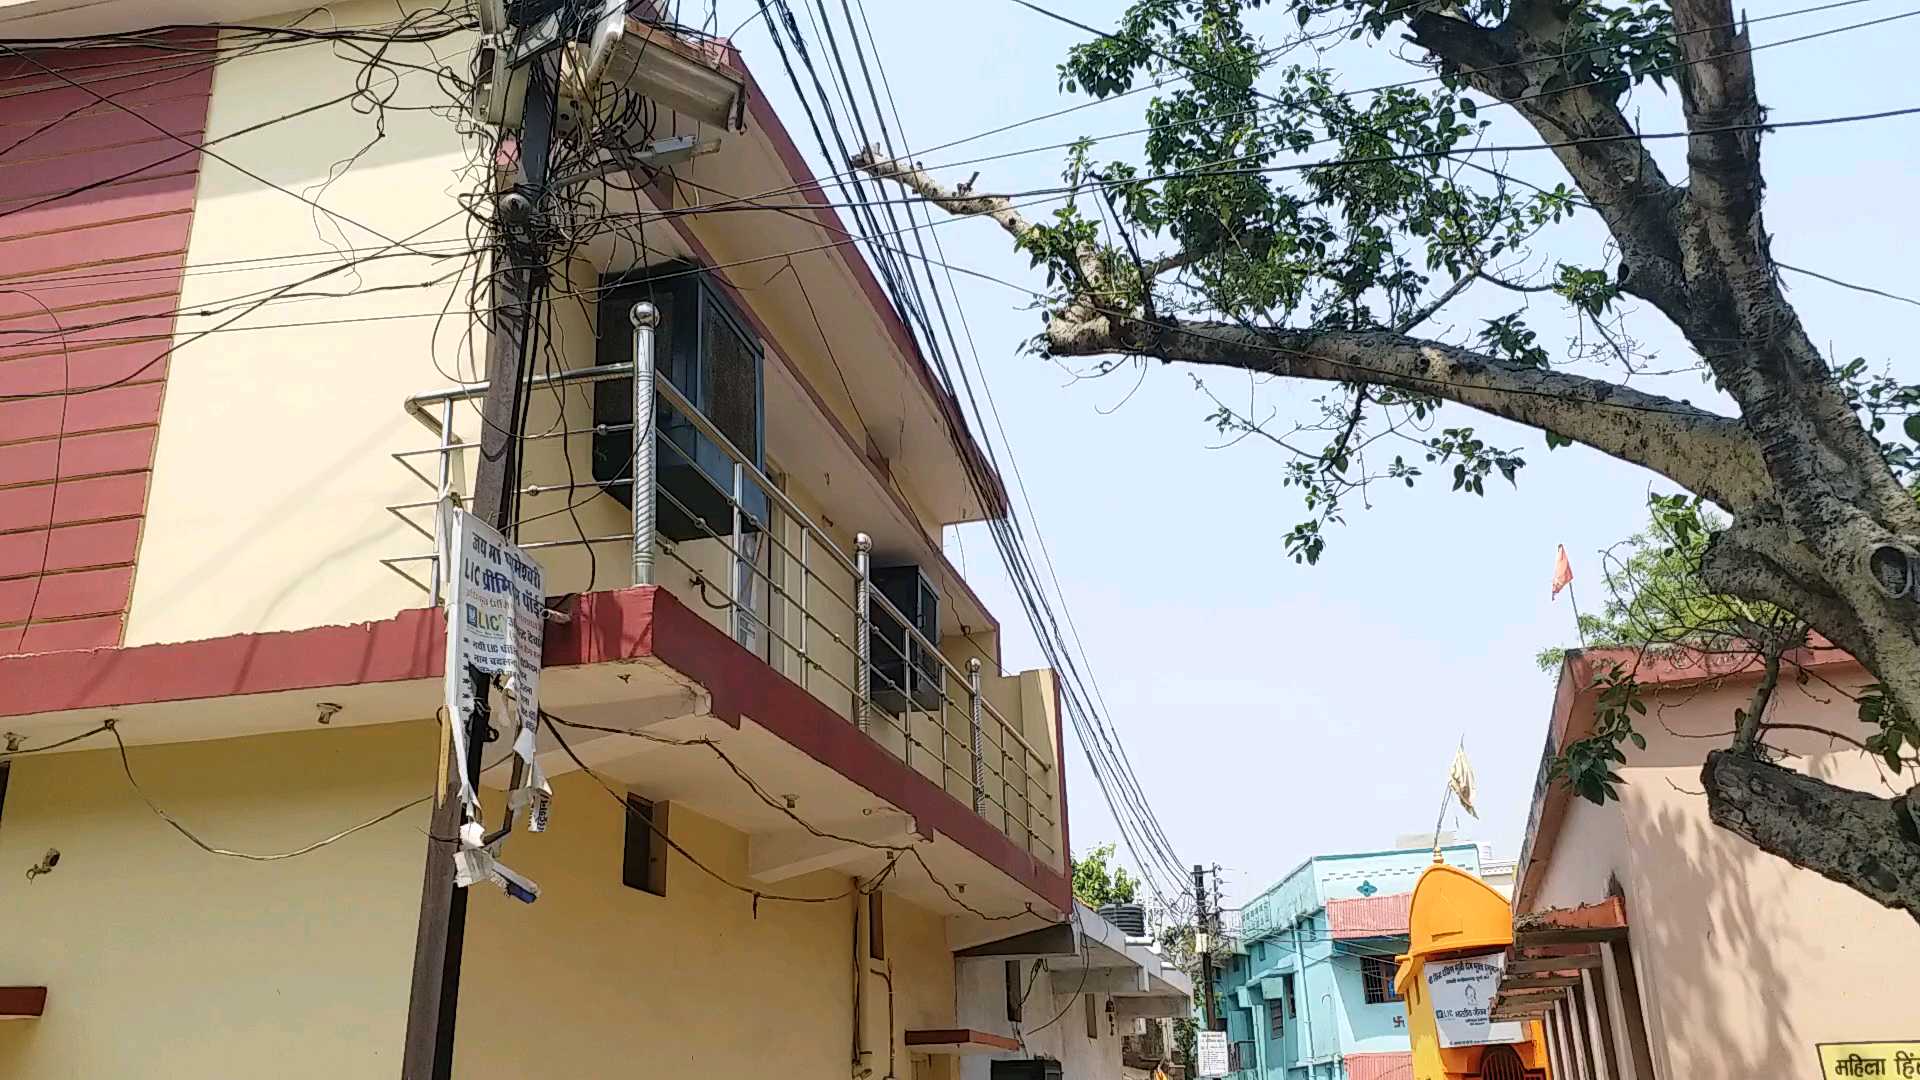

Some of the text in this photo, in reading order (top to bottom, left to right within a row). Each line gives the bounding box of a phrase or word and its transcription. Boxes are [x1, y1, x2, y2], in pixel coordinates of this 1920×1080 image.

[472, 532, 487, 558] जय
[465, 558, 481, 586] LIC
[479, 611, 500, 631] LIC
[1835, 1050, 1920, 1079] महिला हिं
